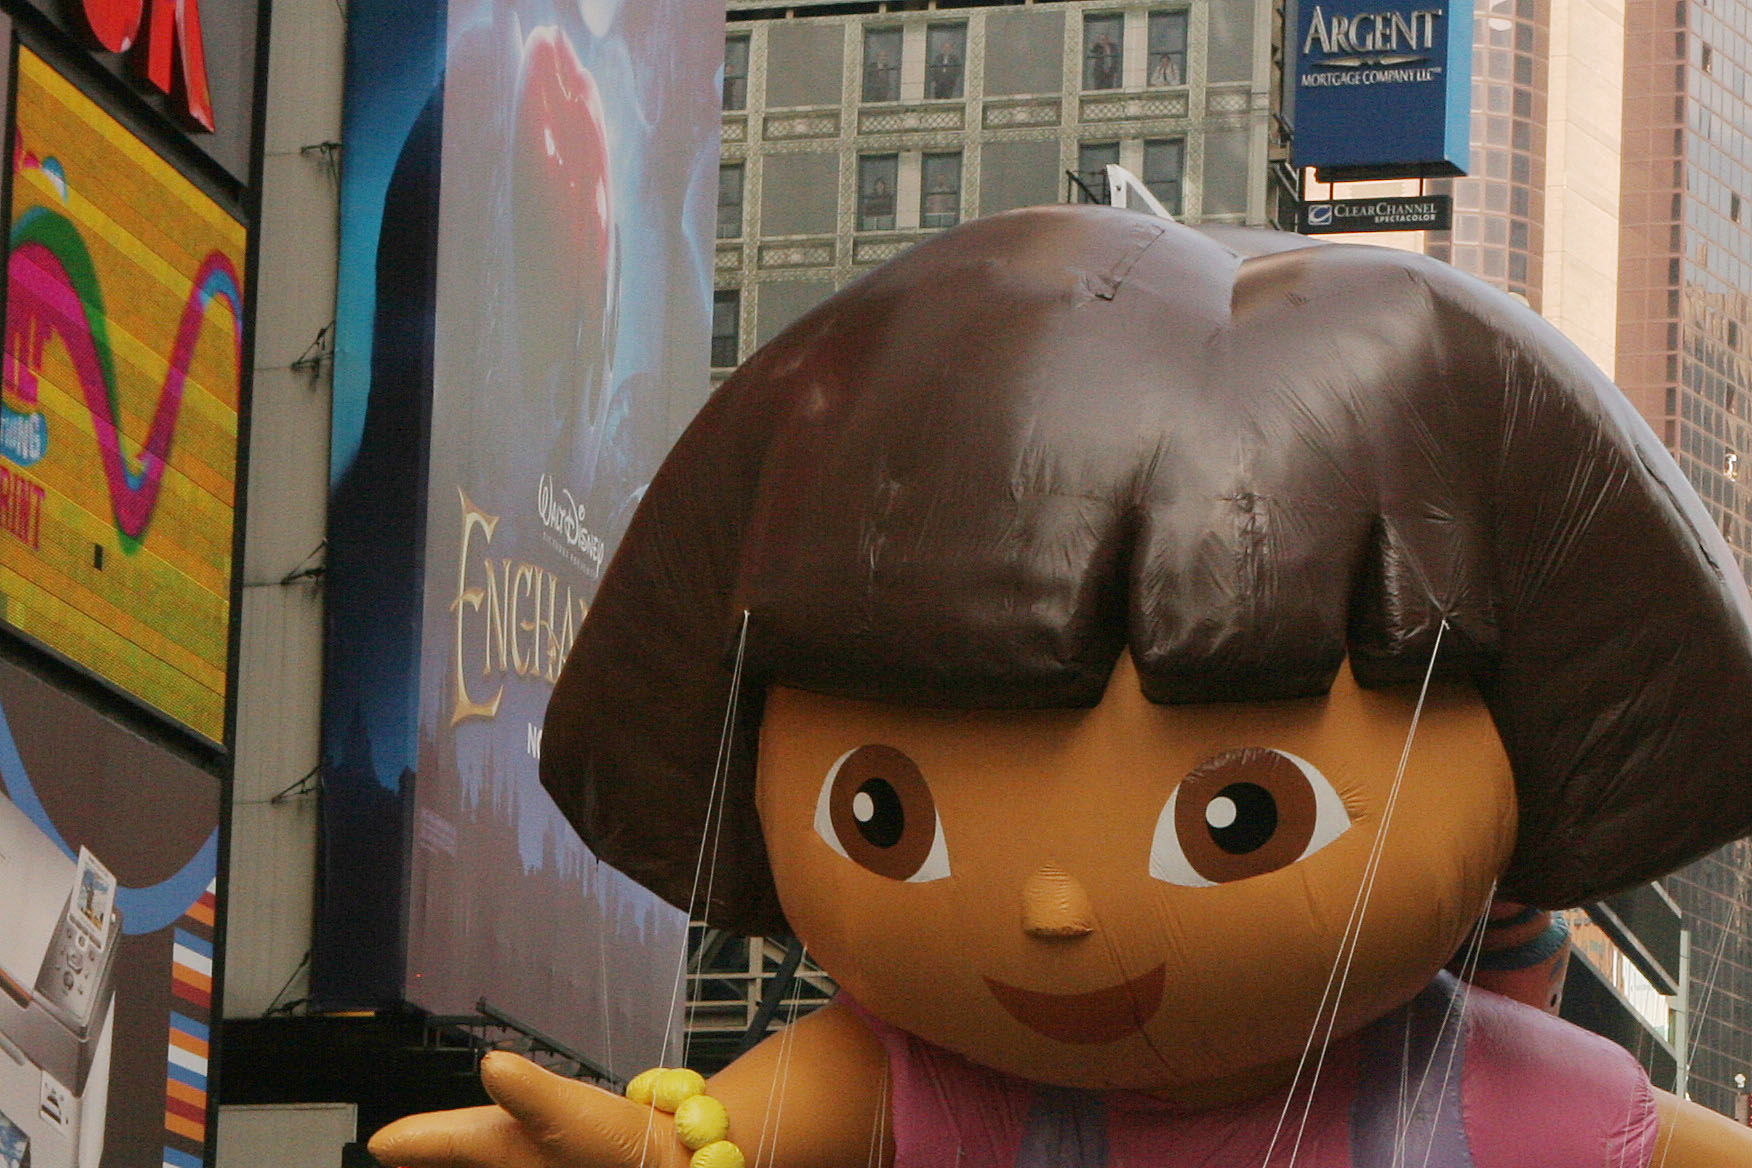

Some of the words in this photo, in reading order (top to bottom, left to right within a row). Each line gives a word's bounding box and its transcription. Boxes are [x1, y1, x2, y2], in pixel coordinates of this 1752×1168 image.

[1303, 6, 1442, 54] ARGENT
[1301, 70, 1361, 87] MORTGAGE
[1362, 69, 1414, 85] COMPANY
[1374, 214, 1436, 224] SPECTACOLOR
